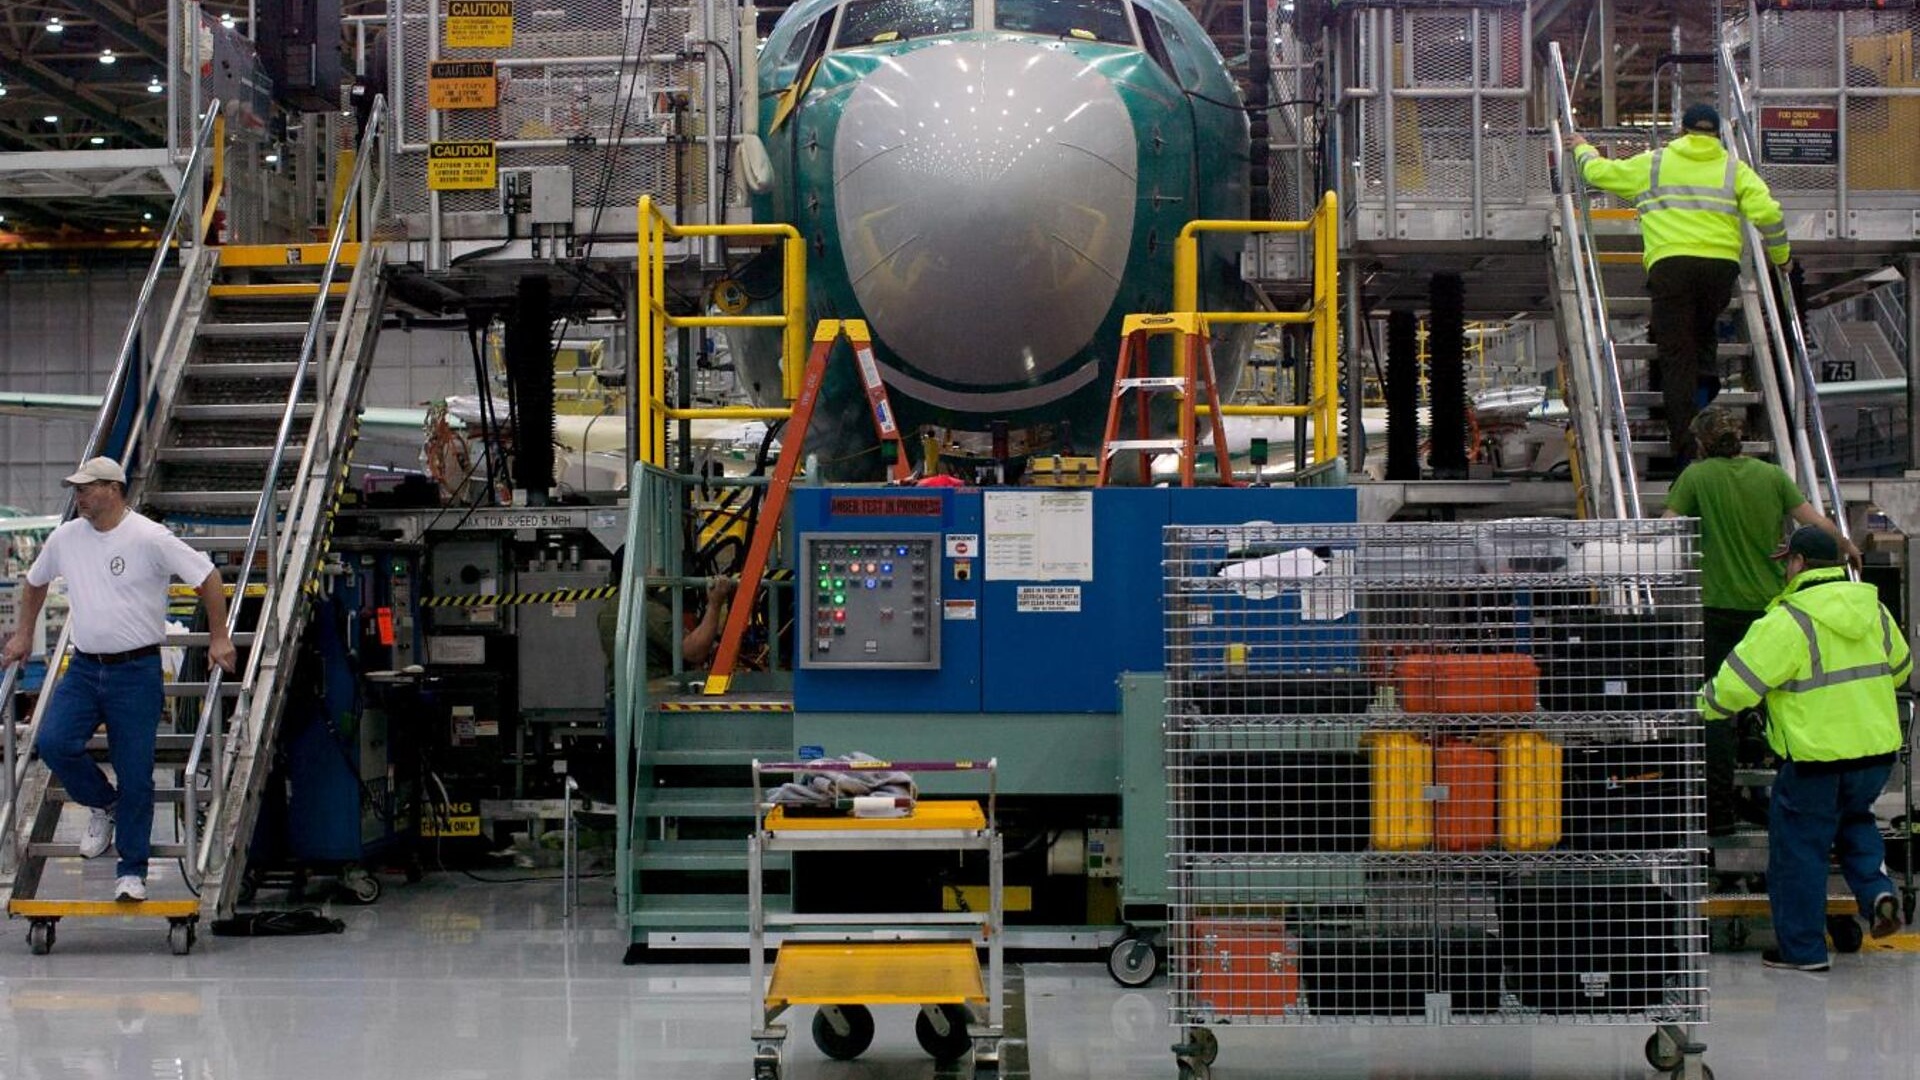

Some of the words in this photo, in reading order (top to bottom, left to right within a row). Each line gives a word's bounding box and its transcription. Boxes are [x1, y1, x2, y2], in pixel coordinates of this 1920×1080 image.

[452, 3, 509, 15] CAUTION
[437, 64, 488, 76] CAUTION
[434, 145, 489, 156] CAUTION
[862, 499, 883, 513] TEST
[885, 499, 894, 513] IN
[896, 499, 941, 513] PROGRESS
[460, 516, 479, 527] MAX
[508, 516, 538, 526] SPEED
[541, 516, 548, 525] 5
[551, 515, 571, 525] MPH
[454, 821, 476, 831] ONLY
